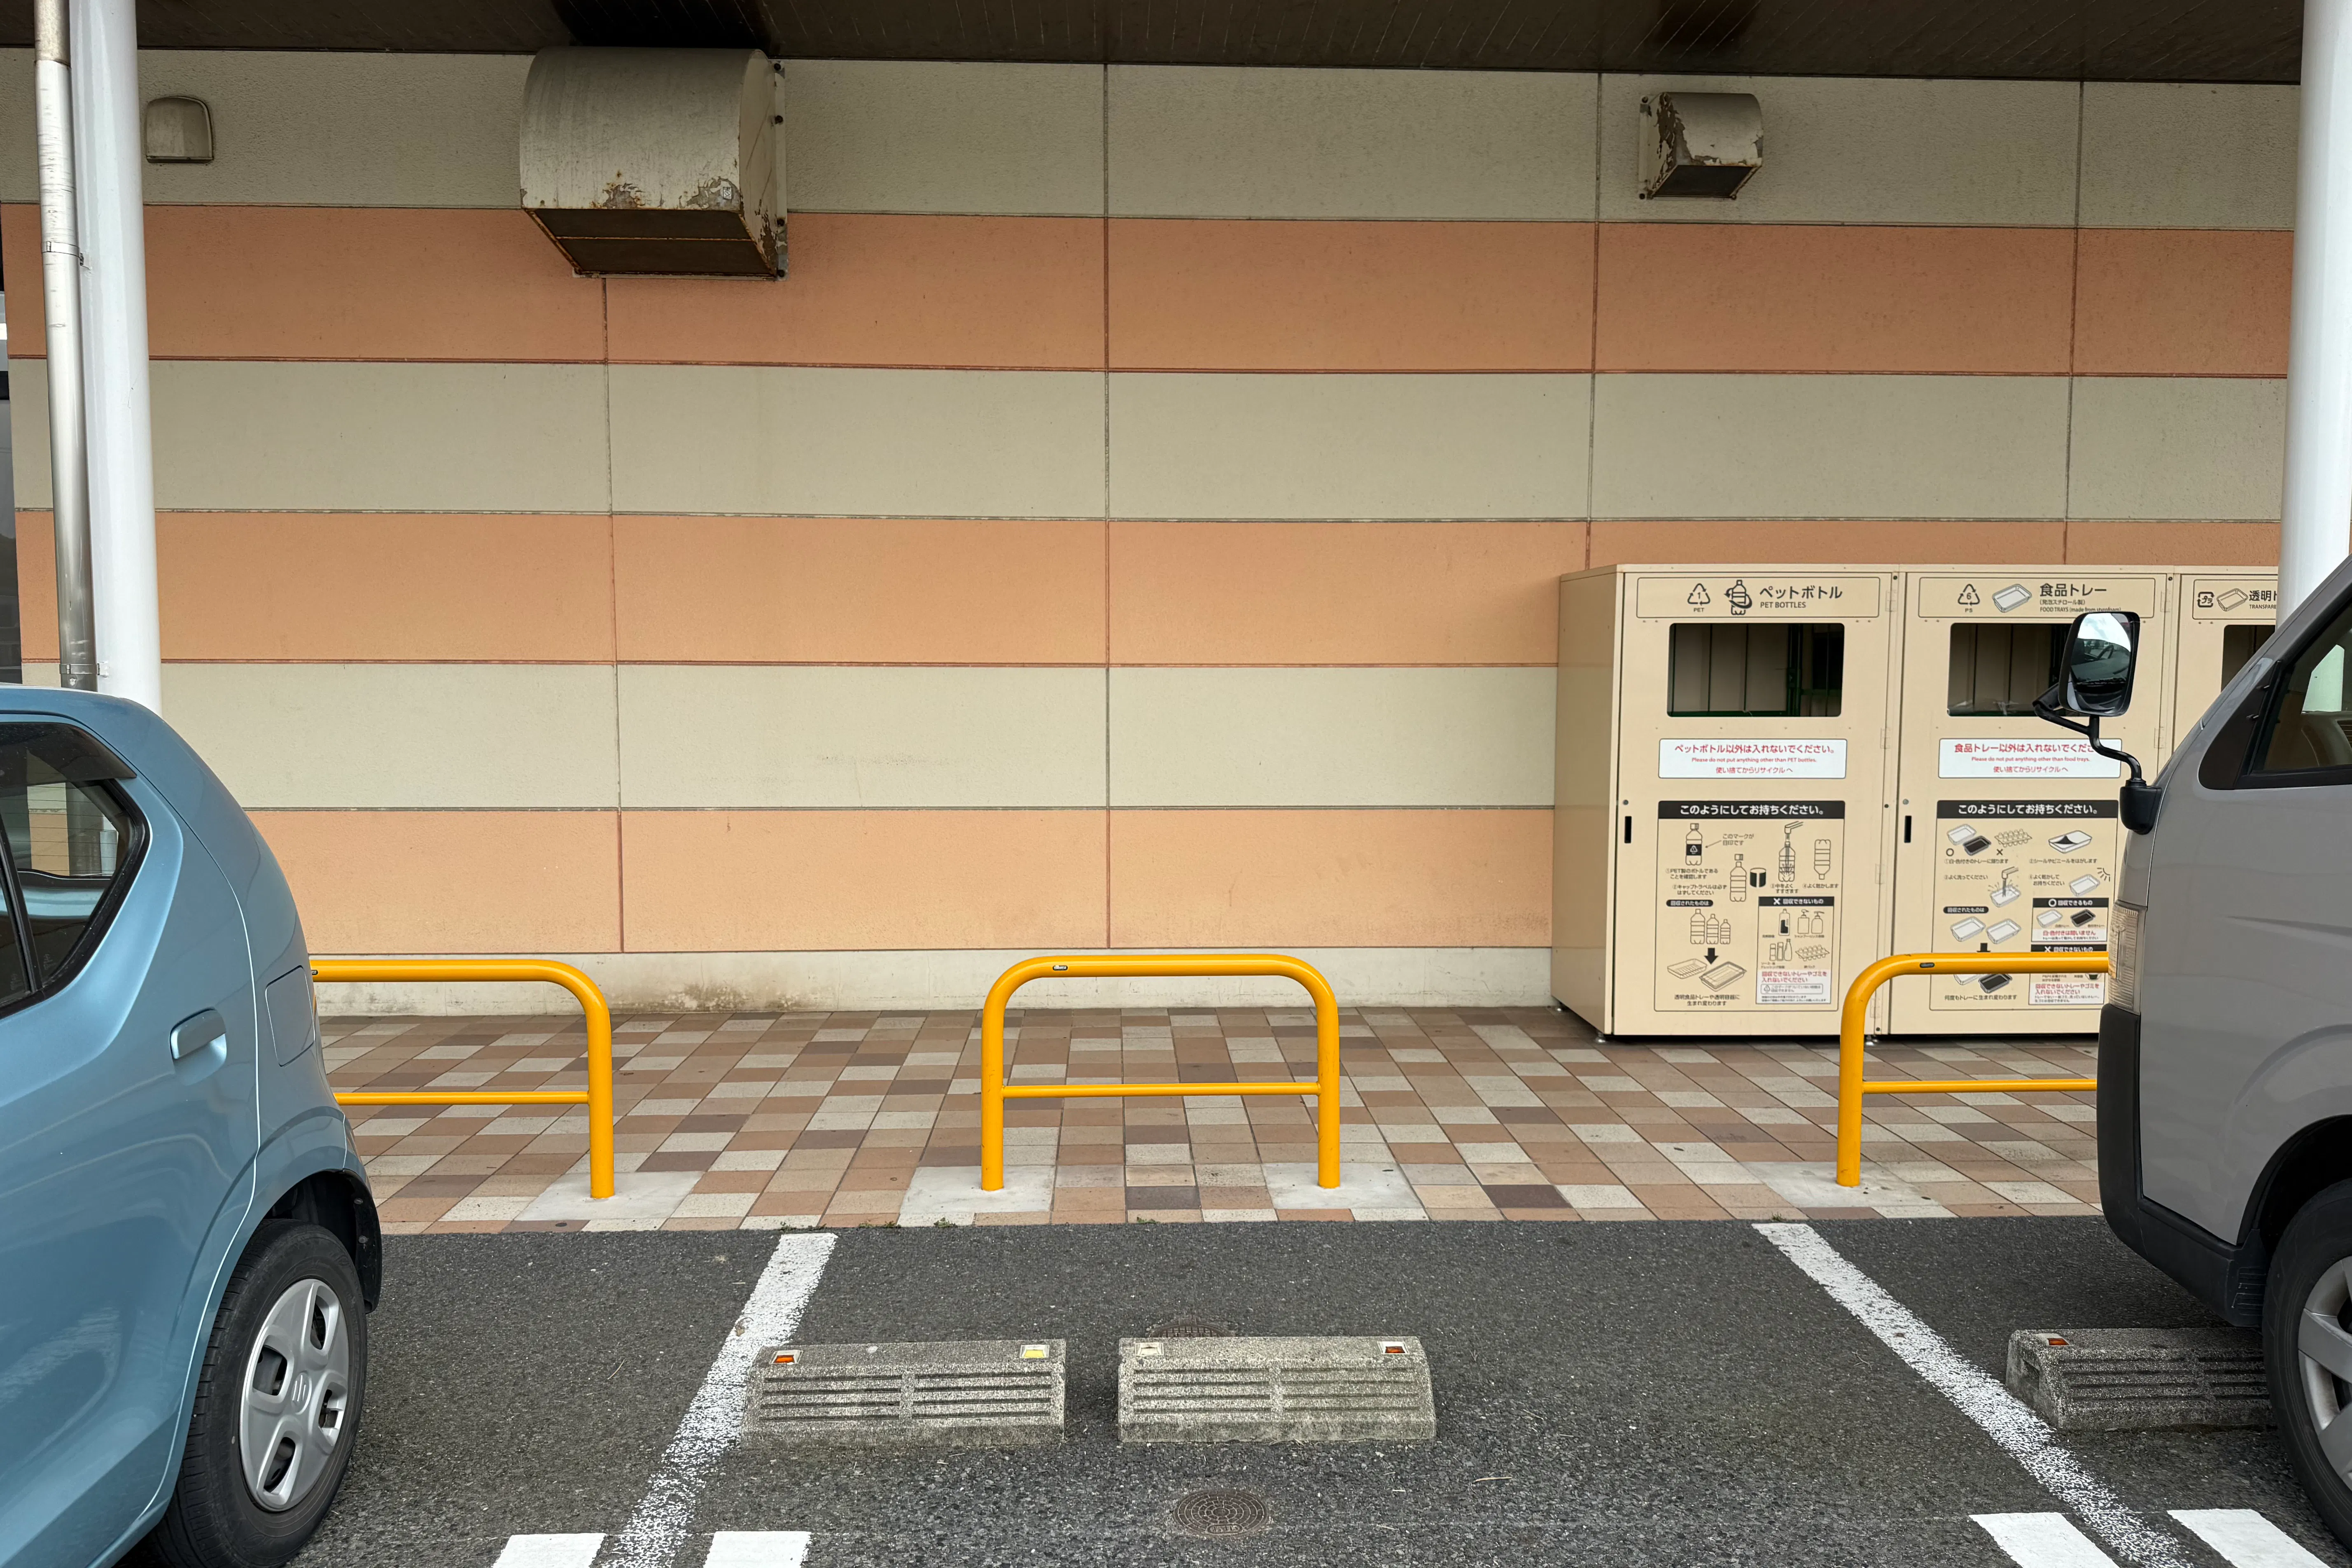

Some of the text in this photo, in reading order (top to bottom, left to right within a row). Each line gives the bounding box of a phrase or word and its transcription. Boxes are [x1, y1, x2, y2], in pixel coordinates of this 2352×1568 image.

[1759, 586, 1842, 599] ペットボトル
[2040, 583, 2107, 597] 食品トレー
[1675, 744, 1834, 754] ペットボトル以外は入れないでください。
[1680, 805, 1824, 815] このようにしてお持ちください。
[1959, 804, 2097, 814] このようにしてお持ちください。
